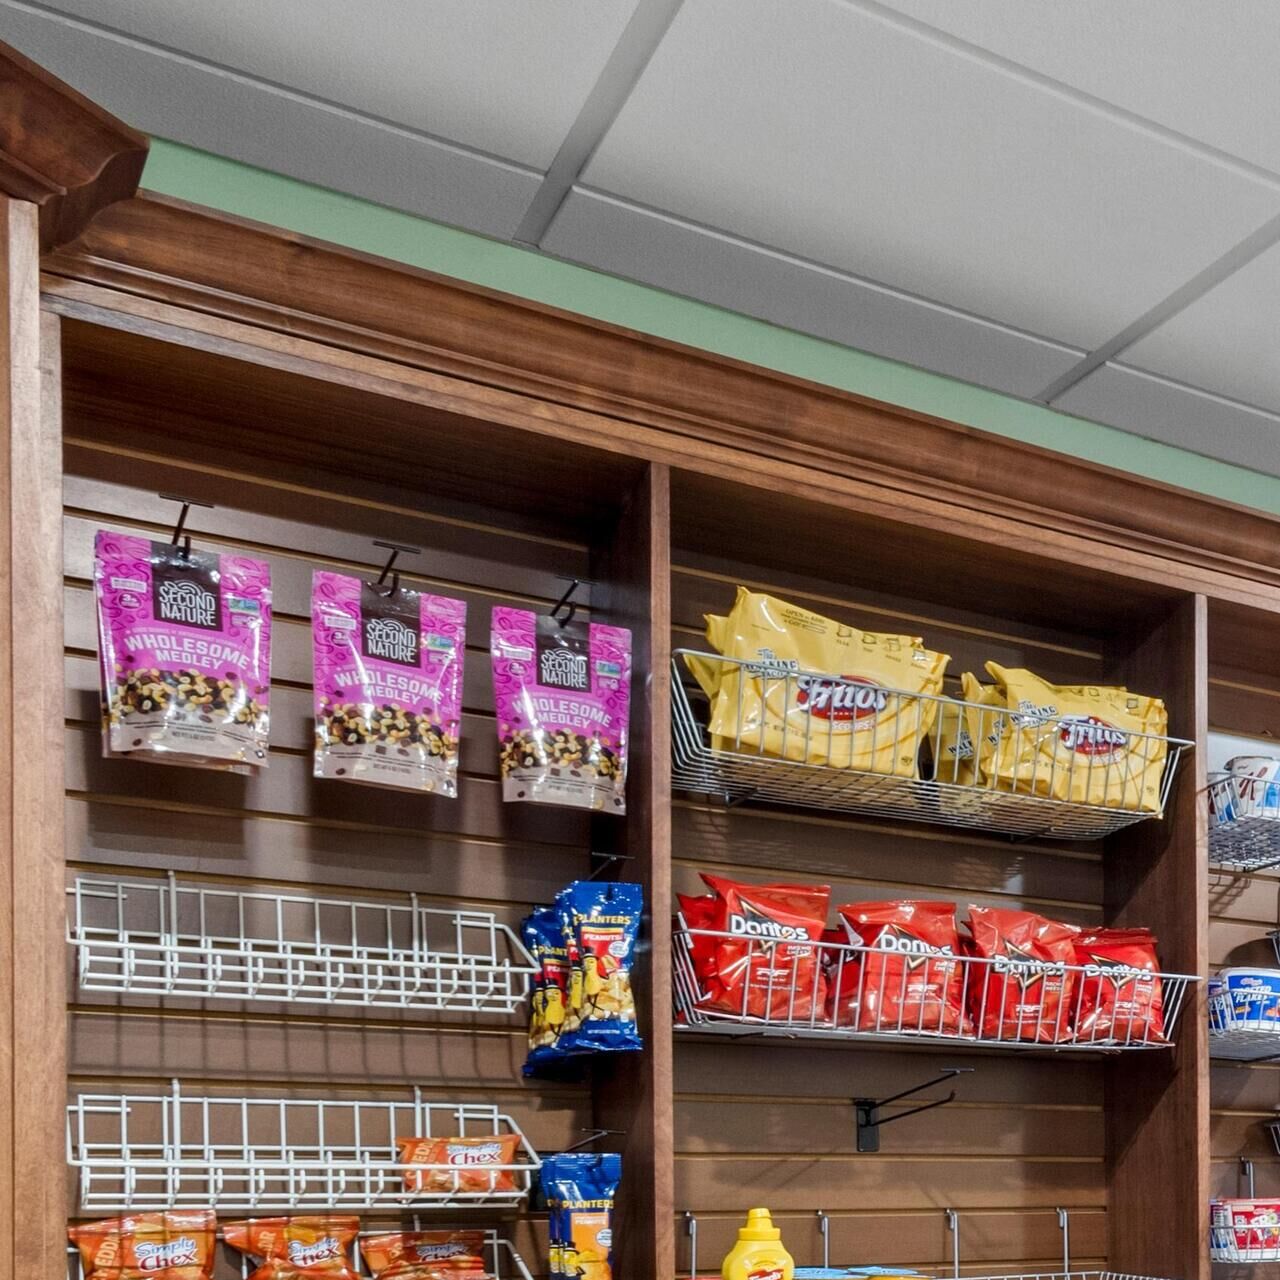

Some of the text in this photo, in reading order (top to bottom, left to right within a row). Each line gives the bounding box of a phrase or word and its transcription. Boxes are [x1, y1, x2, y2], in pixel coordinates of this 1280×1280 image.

[158, 582, 217, 611] SECOND
[160, 603, 217, 627] NATURE
[366, 622, 416, 648] SECOND
[124, 634, 251, 670] WHOLESOME
[155, 650, 223, 670] MEDLEY
[368, 639, 416, 663] NATURE
[541, 653, 587, 674] SECOND
[334, 670, 444, 704] WHOLESOME
[542, 669, 587, 688] NATURE
[363, 684, 421, 705] MEDLEY
[512, 698, 613, 727] WHOLESOME
[537, 712, 591, 729] MEDLEY
[574, 914, 631, 925] PLANTERS
[730, 915, 809, 941] Doritos
[538, 945, 567, 956] PLANT
[450, 1151, 498, 1165] Chex
[136, 1237, 196, 1257] Simply
[140, 1251, 197, 1271] Chex
